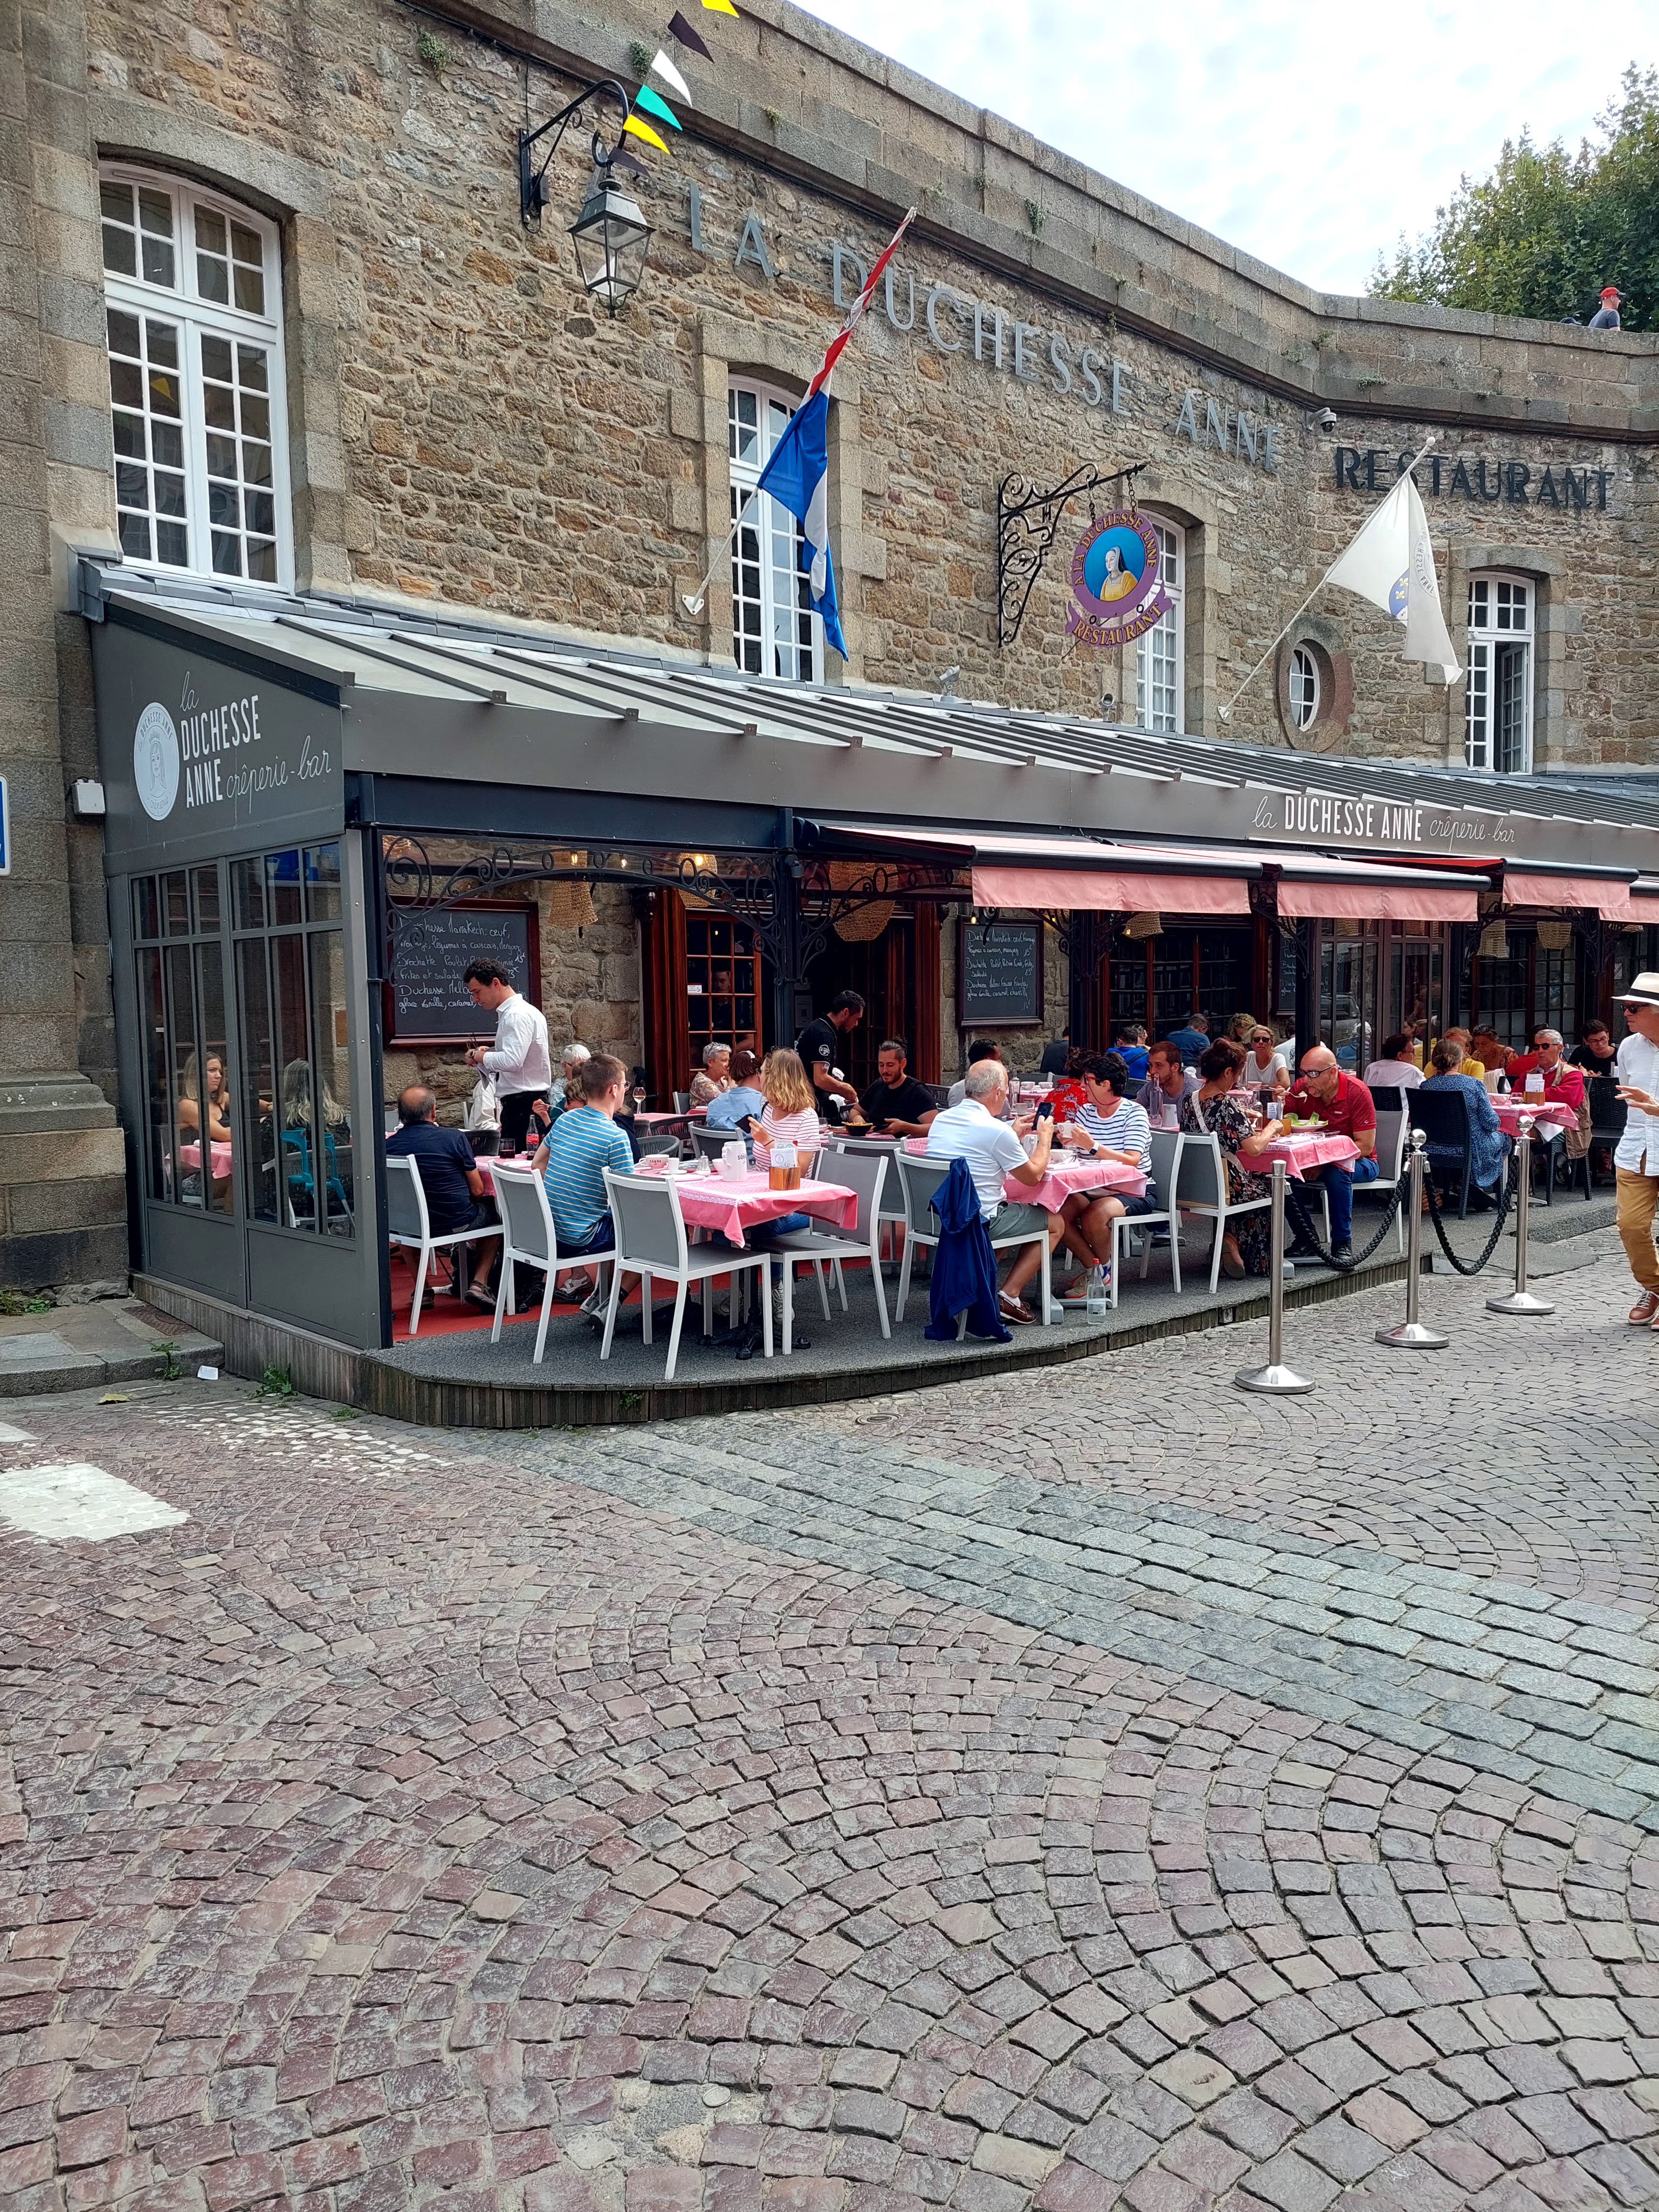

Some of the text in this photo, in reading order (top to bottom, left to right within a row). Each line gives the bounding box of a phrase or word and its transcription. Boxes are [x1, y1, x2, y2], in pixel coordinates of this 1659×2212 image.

[688, 178, 1282, 473] LA DUCHESSE ANNE
[1335, 447, 1615, 510] RESTAURANT
[1081, 512, 1143, 549] DUCHESSE
[1141, 529, 1158, 567] ANNE
[1073, 602, 1162, 645] RESTAURANT
[180, 671, 199, 711] la
[140, 711, 161, 738] DUCHESSE
[162, 717, 173, 740] ANNE
[181, 695, 261, 761] DUCHESSE
[187, 758, 223, 808] ANNE
[1251, 796, 1278, 829] la
[1285, 795, 1374, 837] DUCHESSE
[1381, 806, 1423, 841] ANNE
[431, 935, 460, 954] légumes
[399, 982, 446, 996] Duchesse
[422, 969, 432, 980] et
[398, 997, 418, 1014] glace
